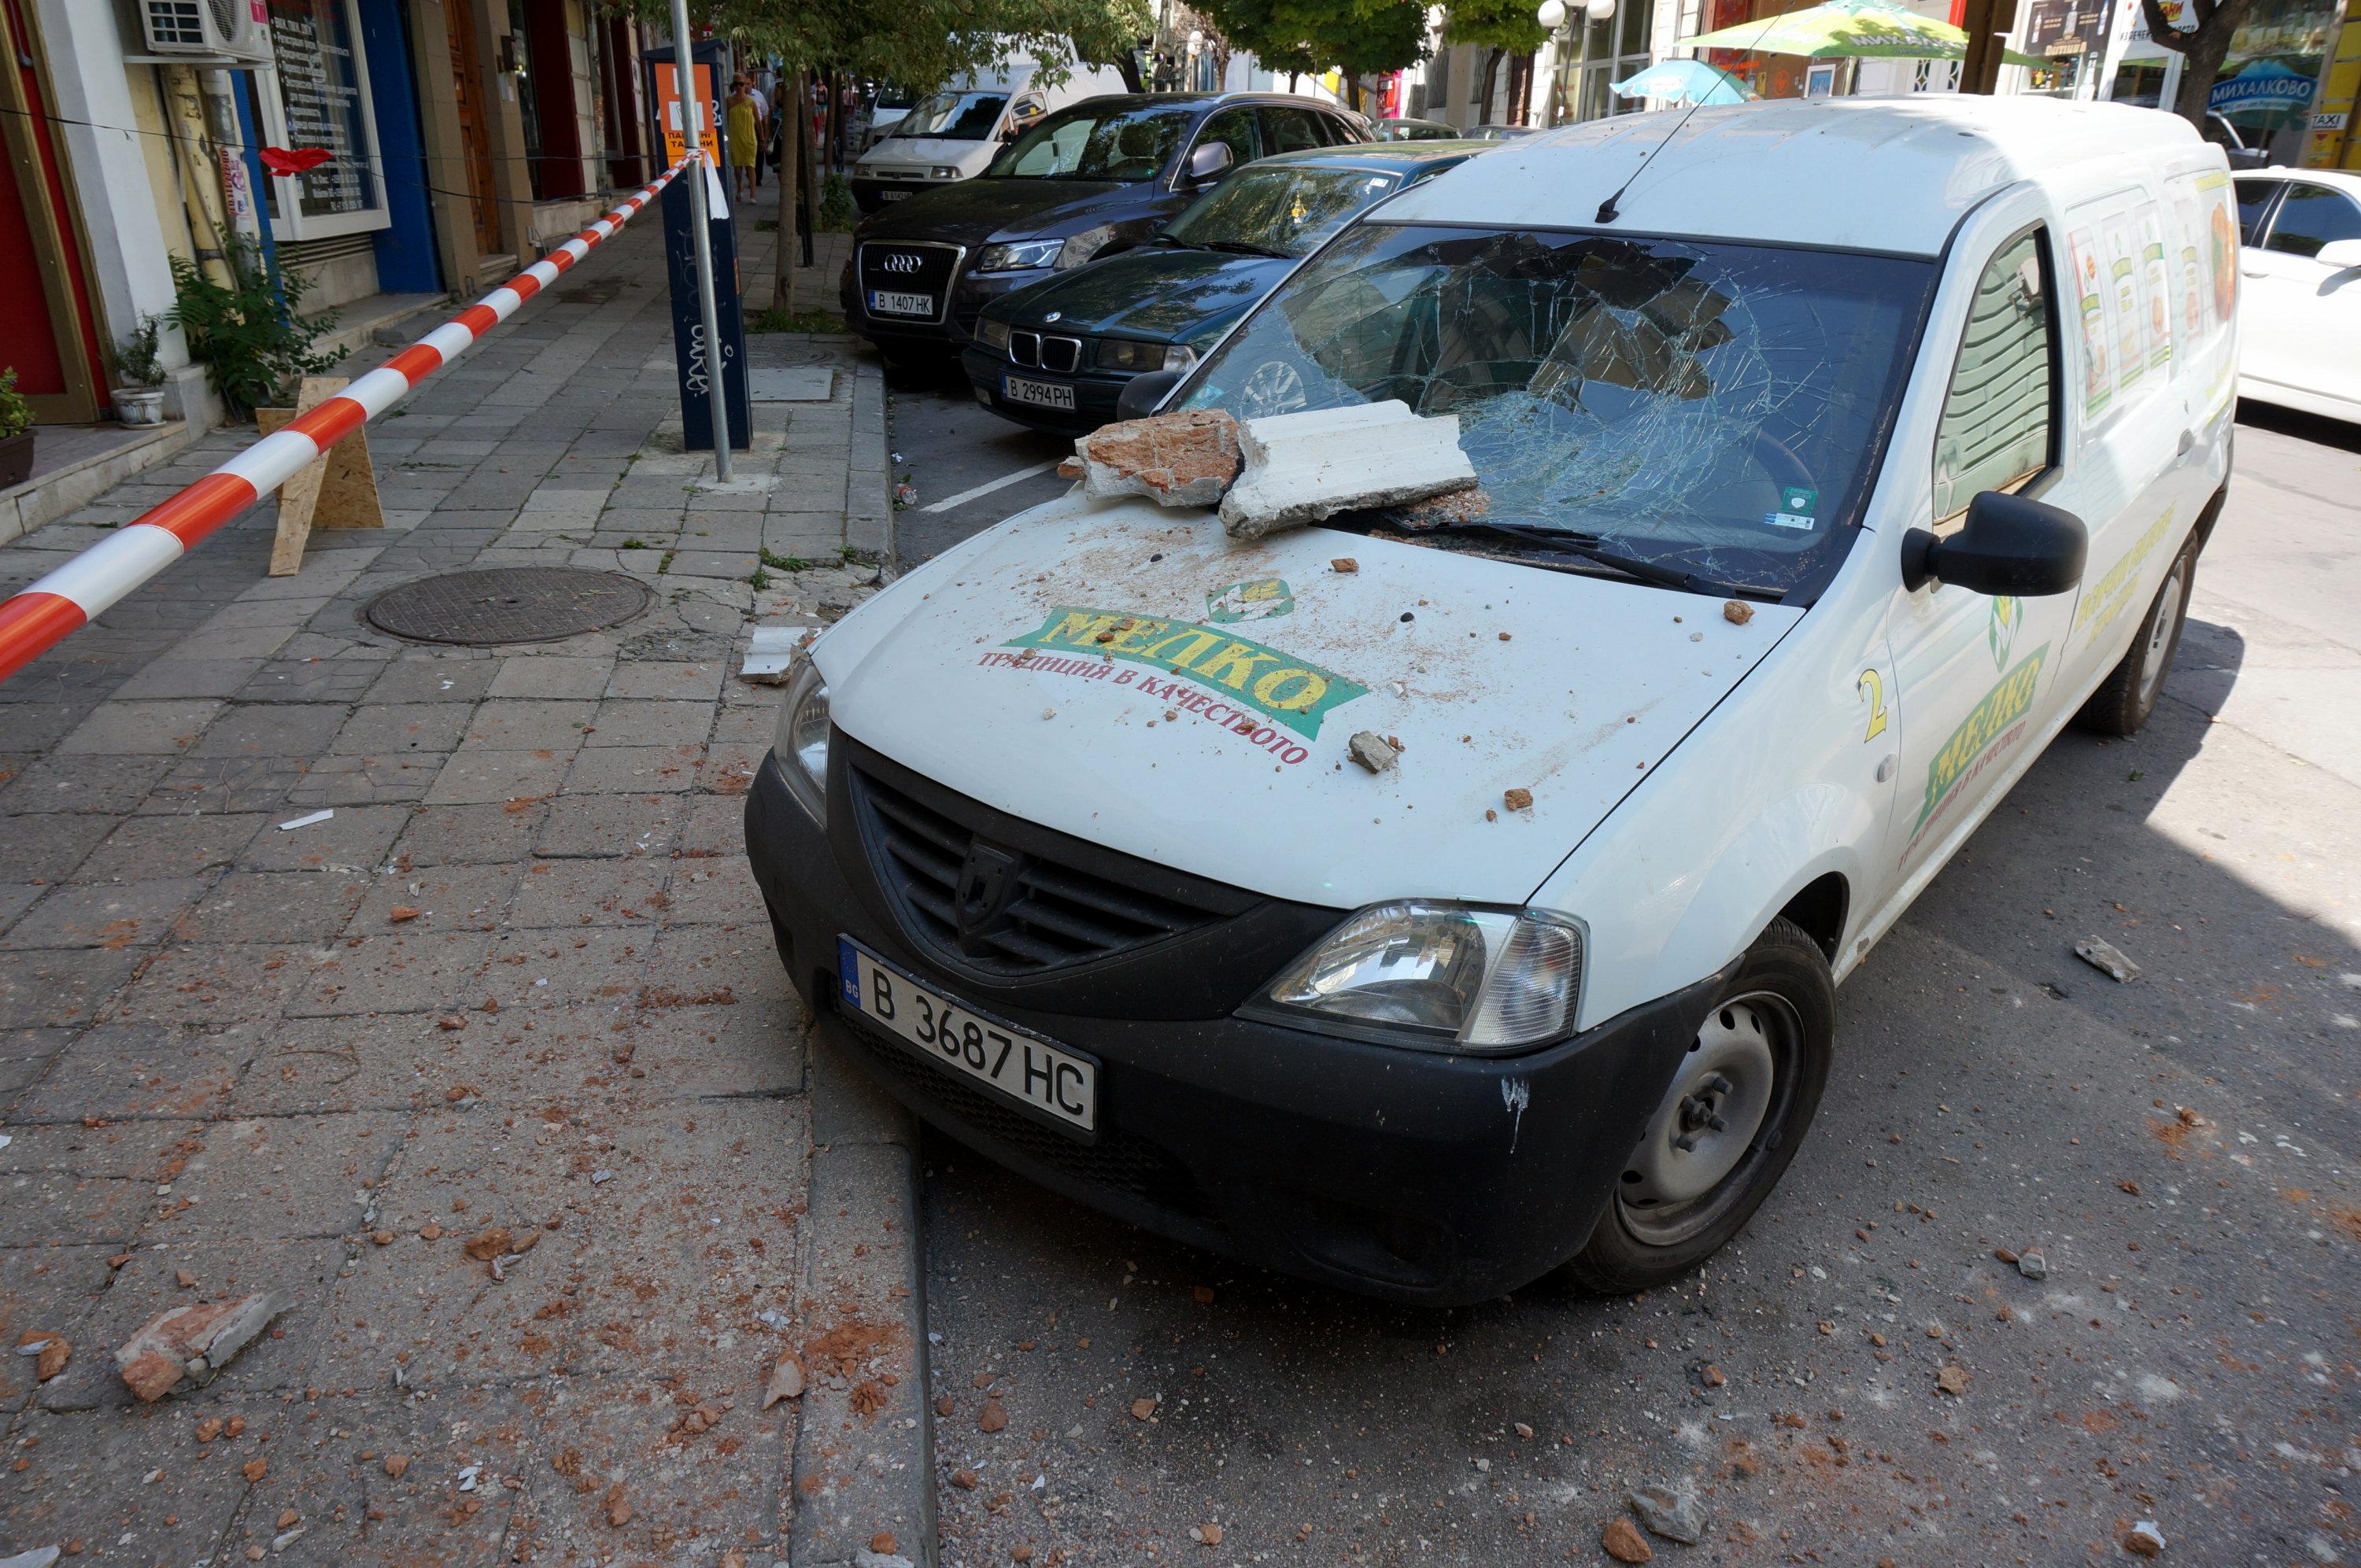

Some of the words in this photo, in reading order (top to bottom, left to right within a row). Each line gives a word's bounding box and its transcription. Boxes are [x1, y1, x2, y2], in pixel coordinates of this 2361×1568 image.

[1849, 35, 1968, 50] МИХАЛКО
[2211, 79, 2311, 103] МИХАЛКОВО
[2313, 114, 2341, 124] TAXI
[878, 293, 885, 308] B
[891, 295, 914, 311] 1407
[916, 297, 930, 313] HK
[1011, 379, 1018, 397] B
[1023, 382, 1051, 404] 2994
[1054, 387, 1073, 406] PH
[1038, 611, 1327, 710] МЕЛКО
[977, 652, 1116, 680] ТРАДИЦИЯ
[1110, 669, 1140, 685] В
[1135, 675, 1309, 765] КАЧЕСТВОТО
[1857, 668, 1888, 744] 2
[1927, 658, 2040, 807] МЕЛКО
[844, 979, 859, 999] BG
[872, 967, 895, 1020] B
[915, 994, 1012, 1079] 3687
[1024, 1046, 1084, 1116] HC
